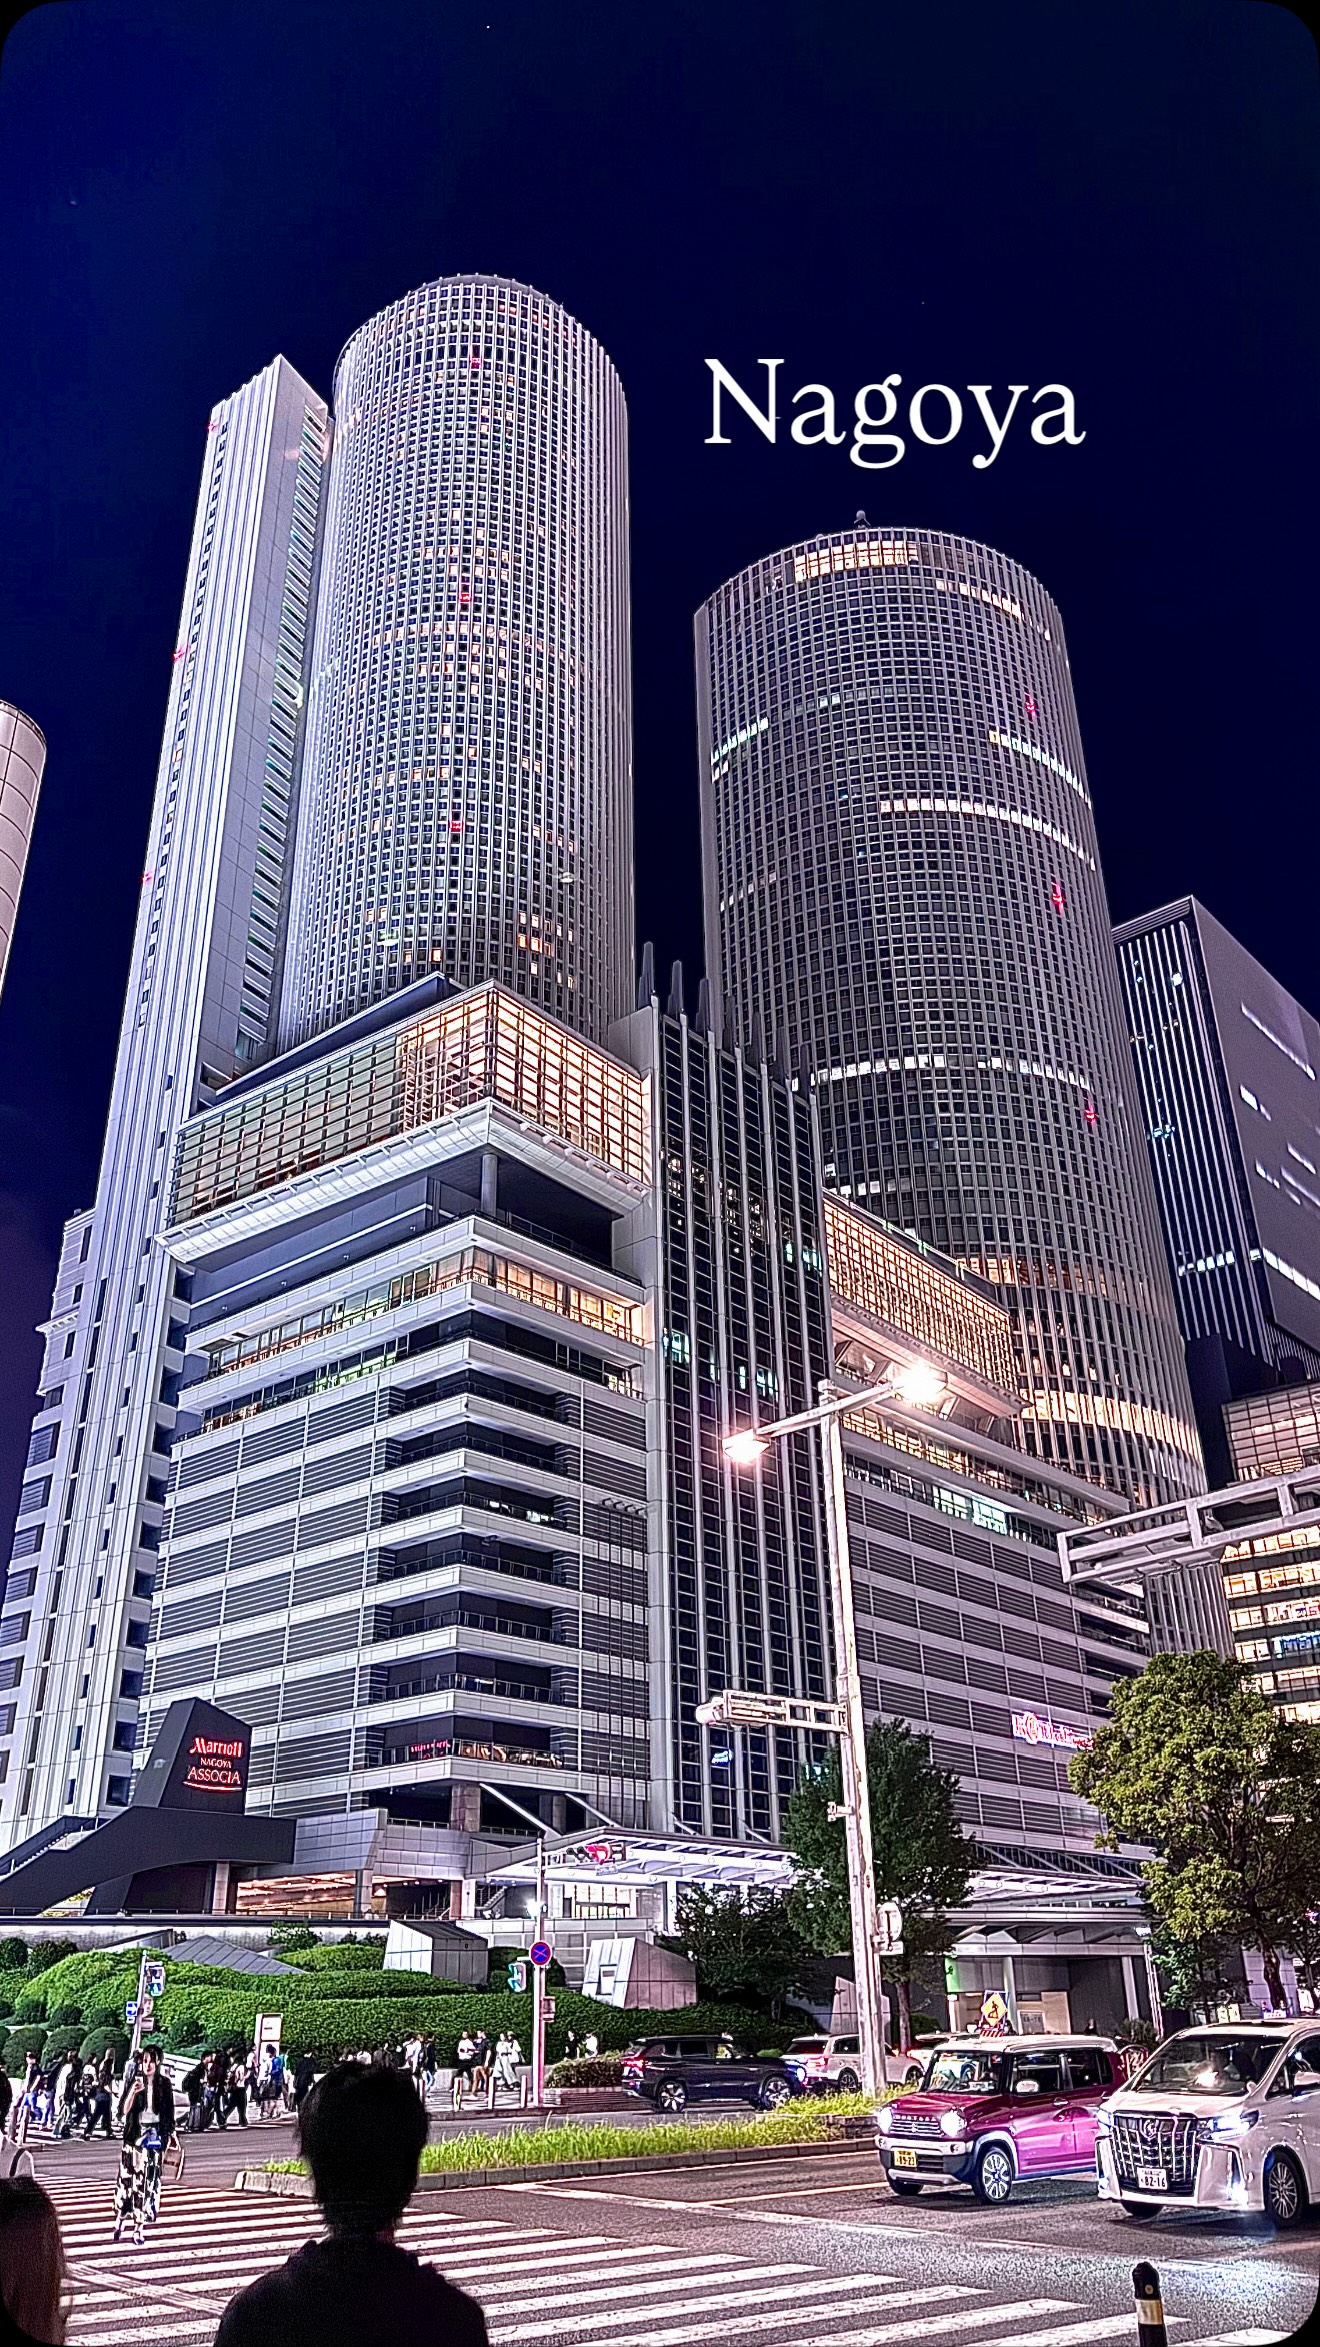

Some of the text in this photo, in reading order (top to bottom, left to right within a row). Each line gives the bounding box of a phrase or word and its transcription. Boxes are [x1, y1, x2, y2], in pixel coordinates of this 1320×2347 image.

[189, 1737, 243, 1757] Marriott
[200, 1757, 232, 1769] NAGOYA
[187, 1766, 241, 1784] ASSOCIA
[1144, 2176, 1166, 2188] 82-16
